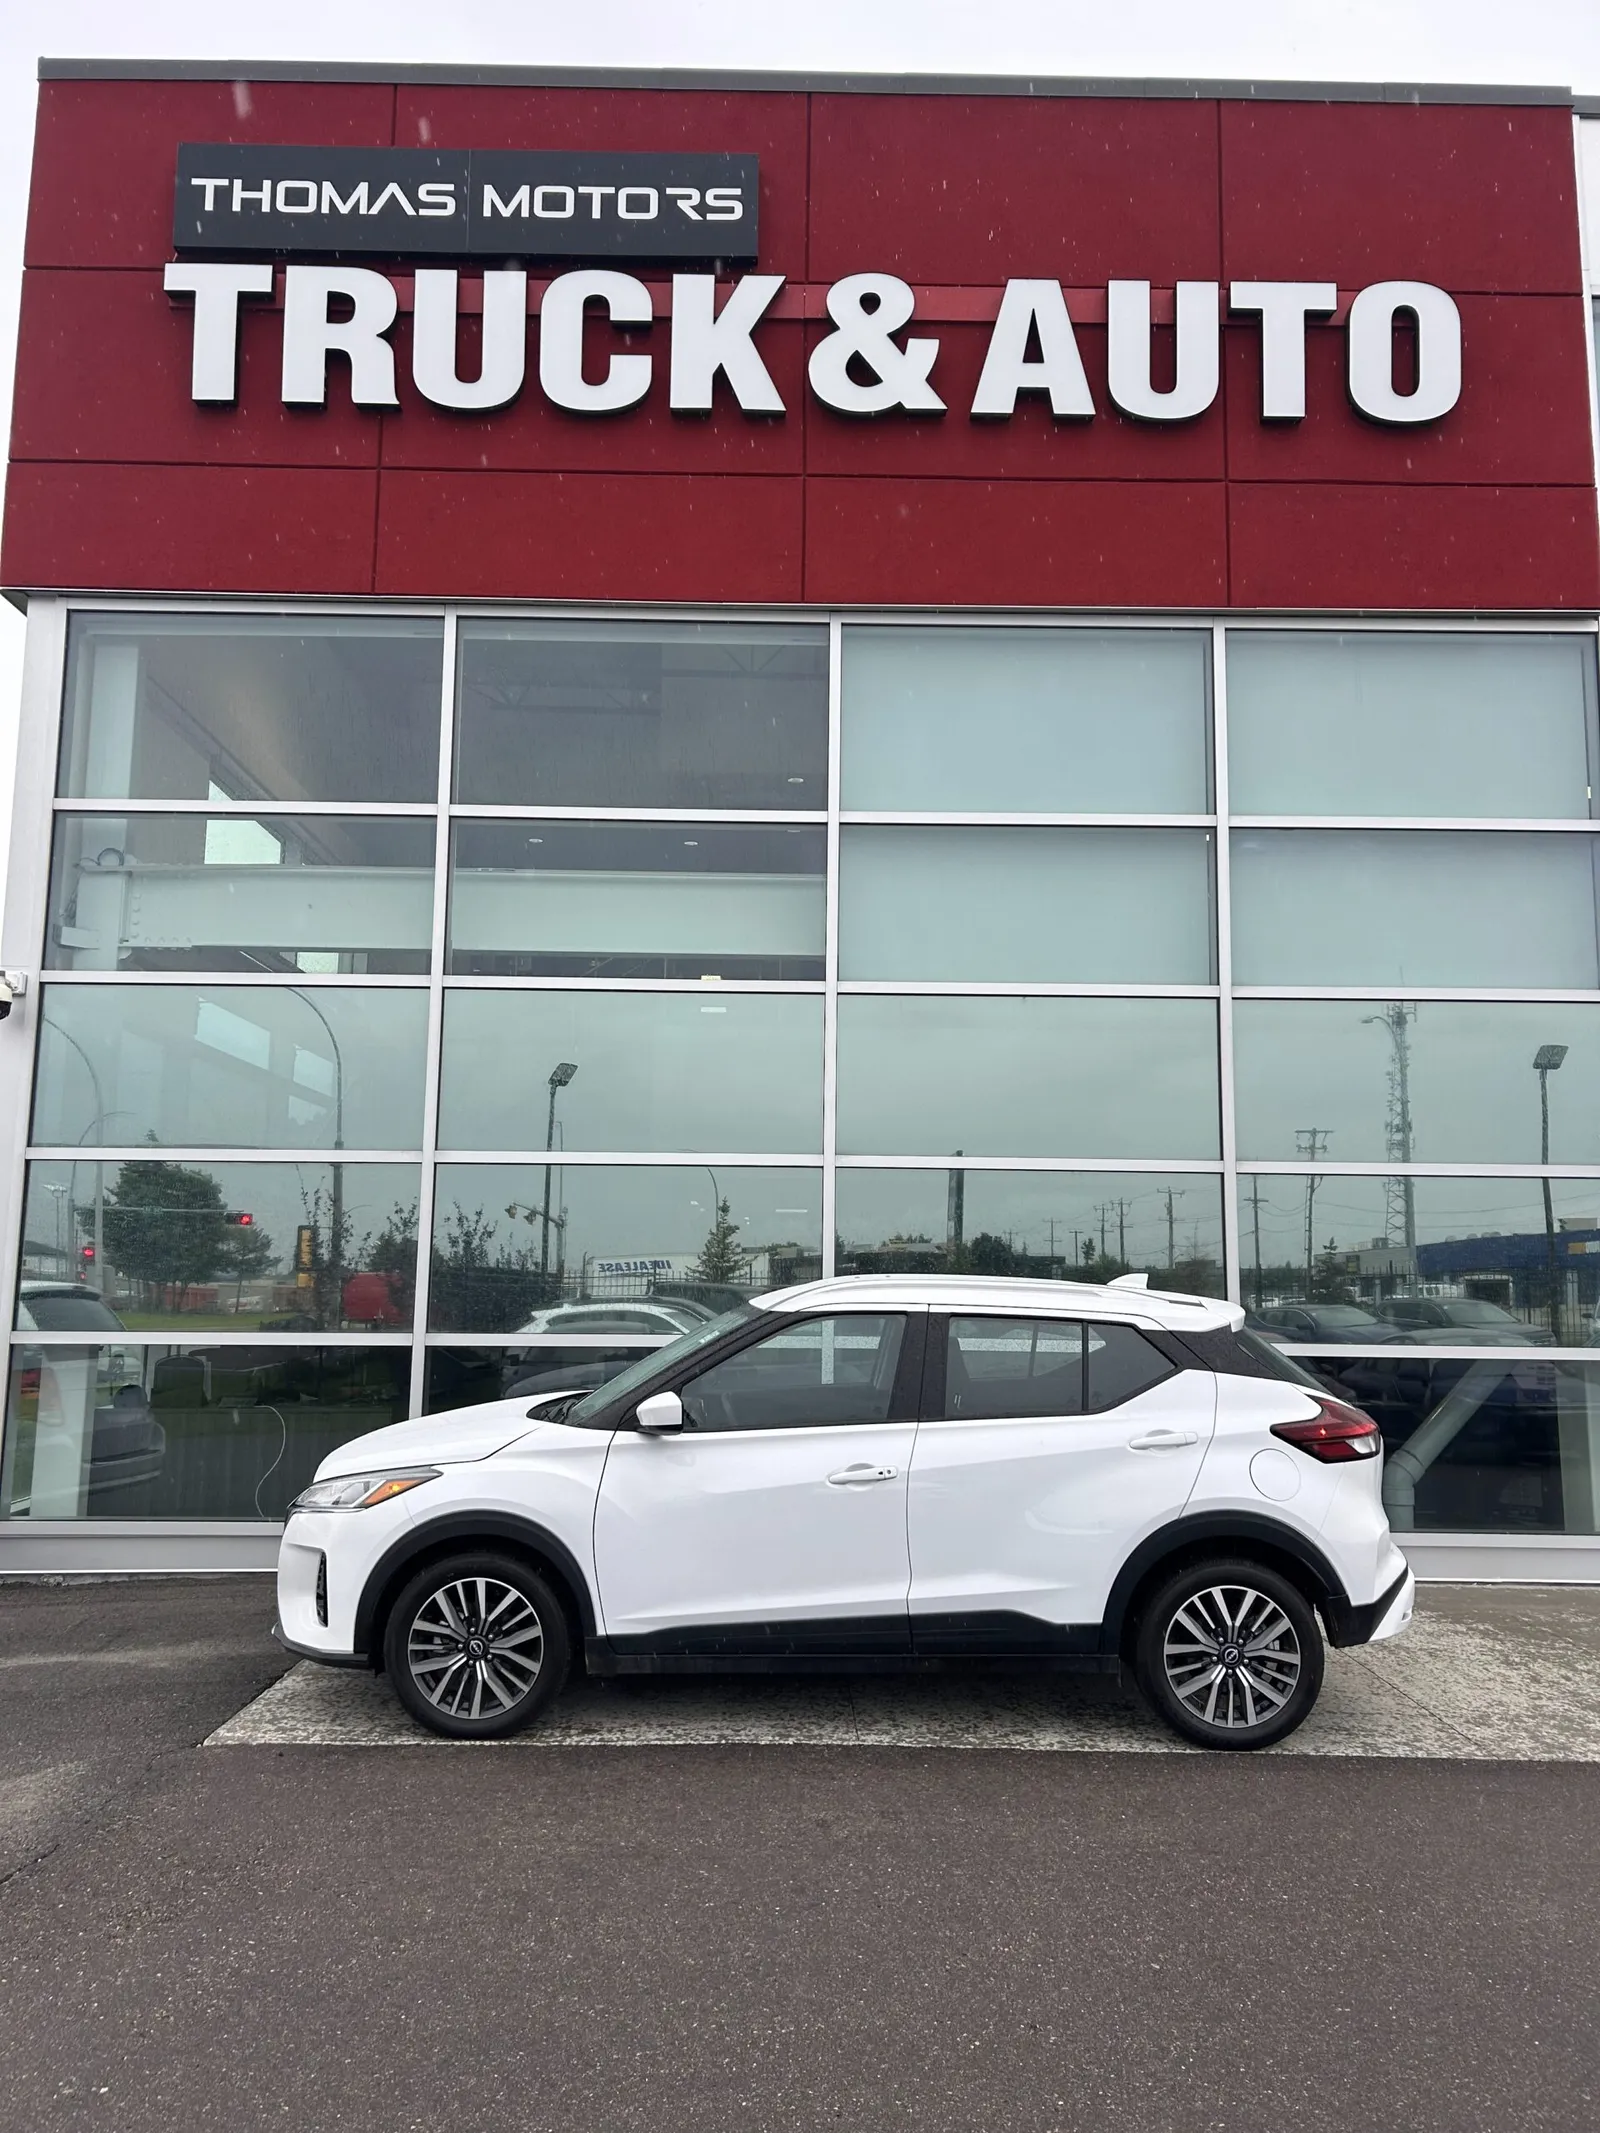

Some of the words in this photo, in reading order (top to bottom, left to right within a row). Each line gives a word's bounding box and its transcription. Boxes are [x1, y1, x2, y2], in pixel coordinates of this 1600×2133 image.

[190, 178, 455, 217] THOMAS
[483, 184, 744, 221] MOTORS
[164, 263, 787, 413] TRUCK
[808, 272, 948, 414] &
[970, 278, 1463, 424] AUTO
